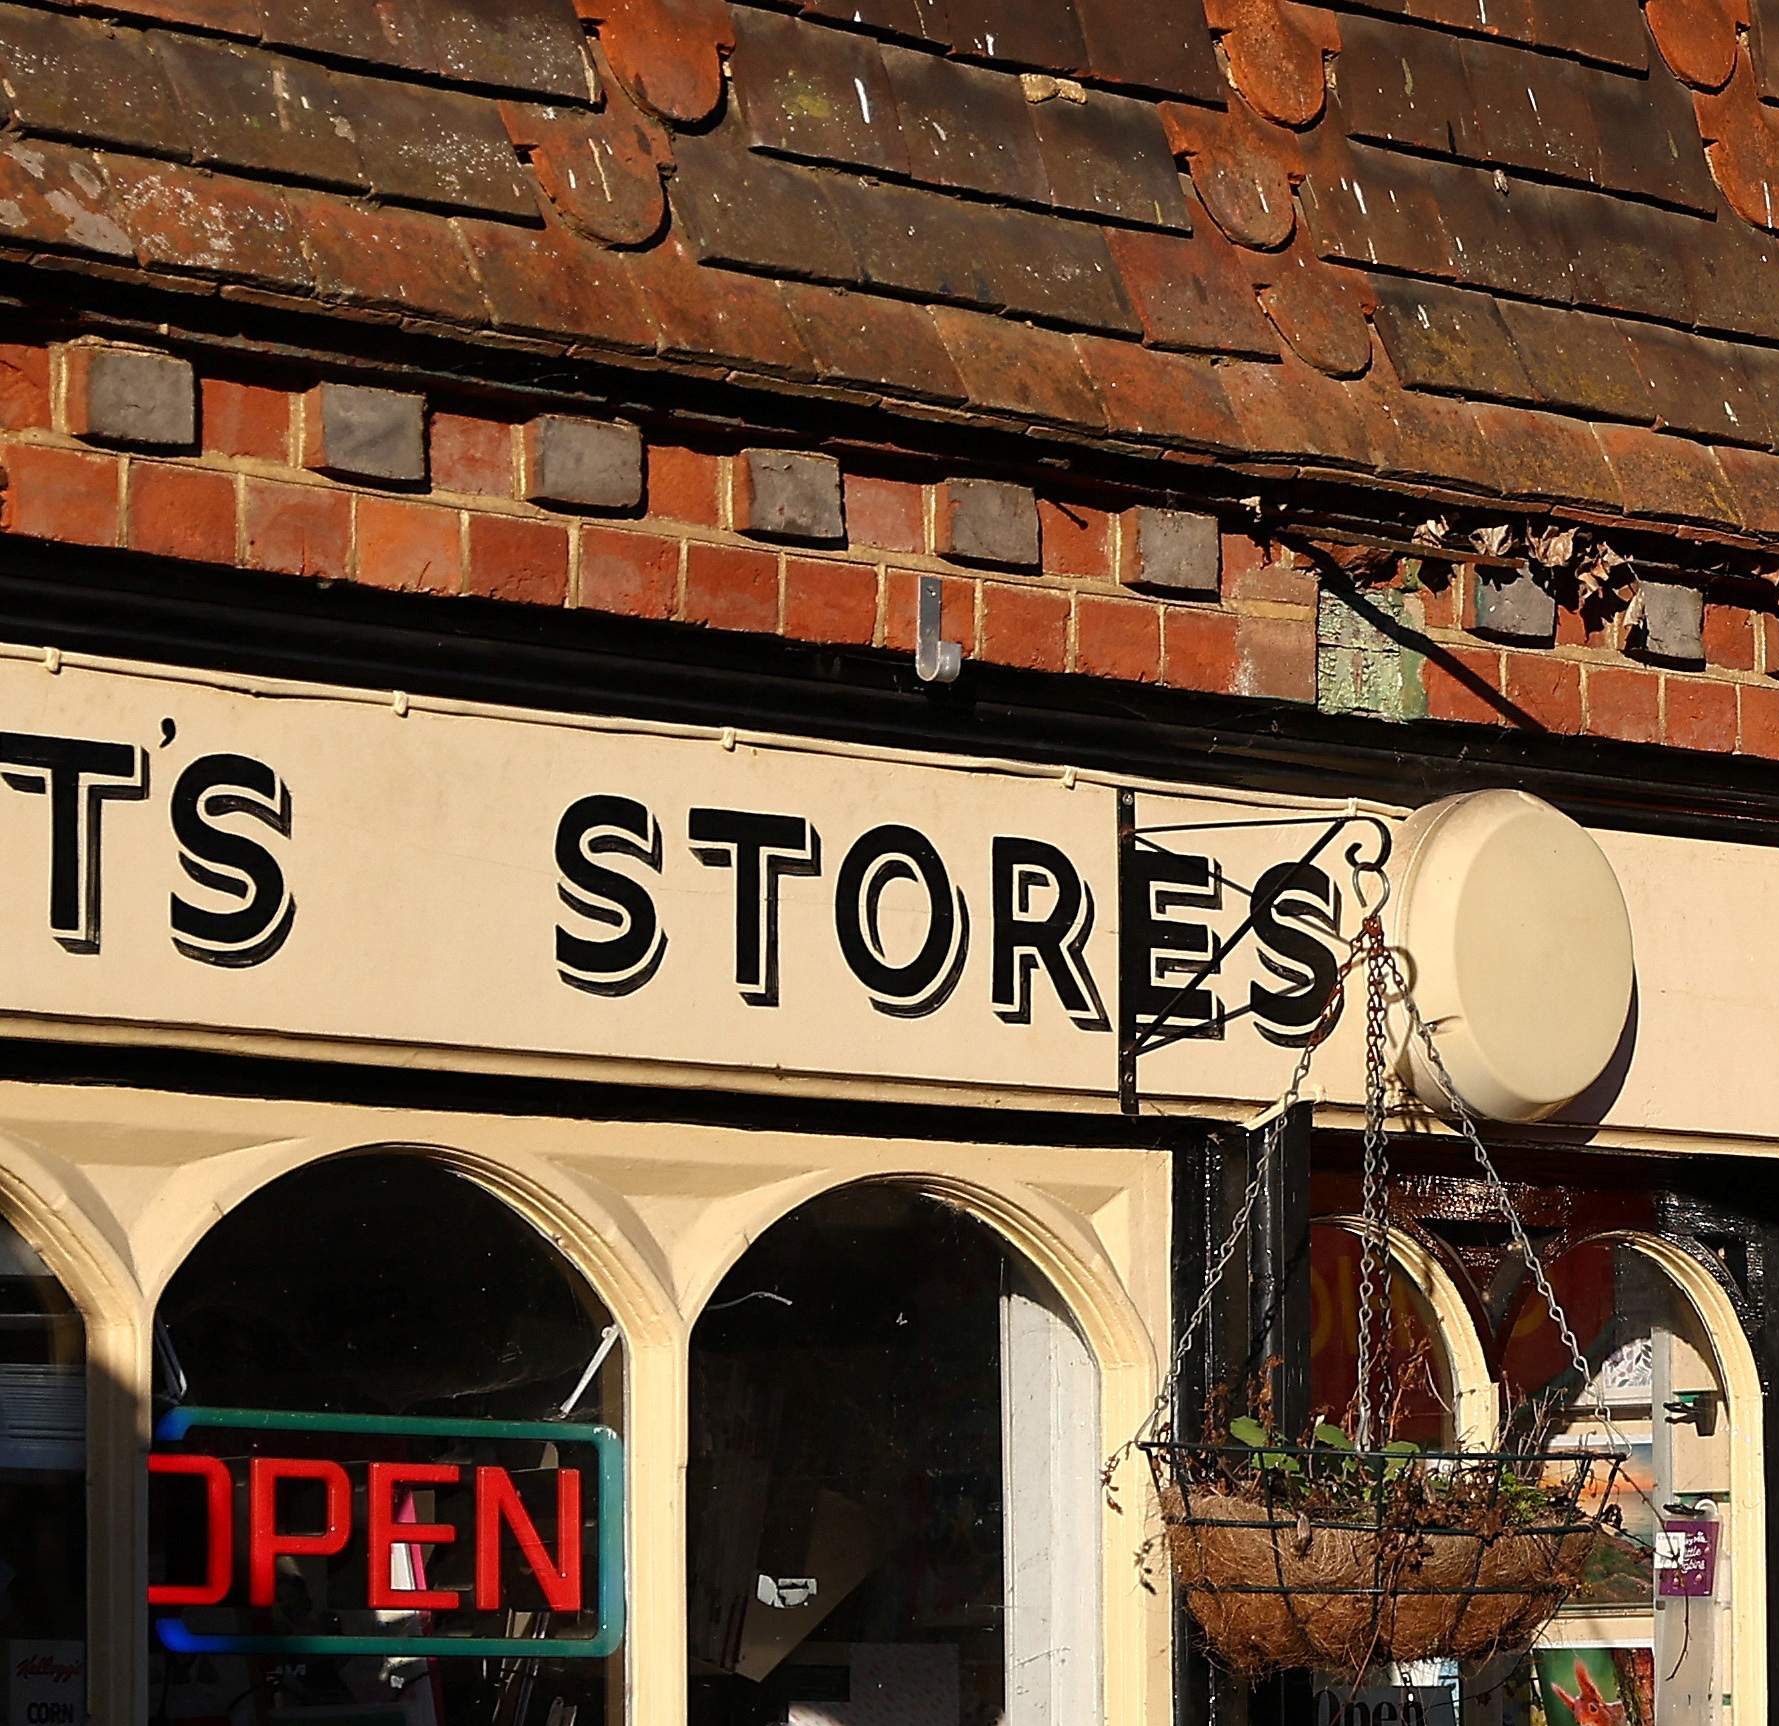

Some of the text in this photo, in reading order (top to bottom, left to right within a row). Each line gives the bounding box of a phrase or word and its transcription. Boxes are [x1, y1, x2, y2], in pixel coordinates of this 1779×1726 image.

[0, 716, 1345, 1048] T'S STORES
[147, 1454, 582, 1611] OPEN
[28, 1702, 73, 1723] CORN
